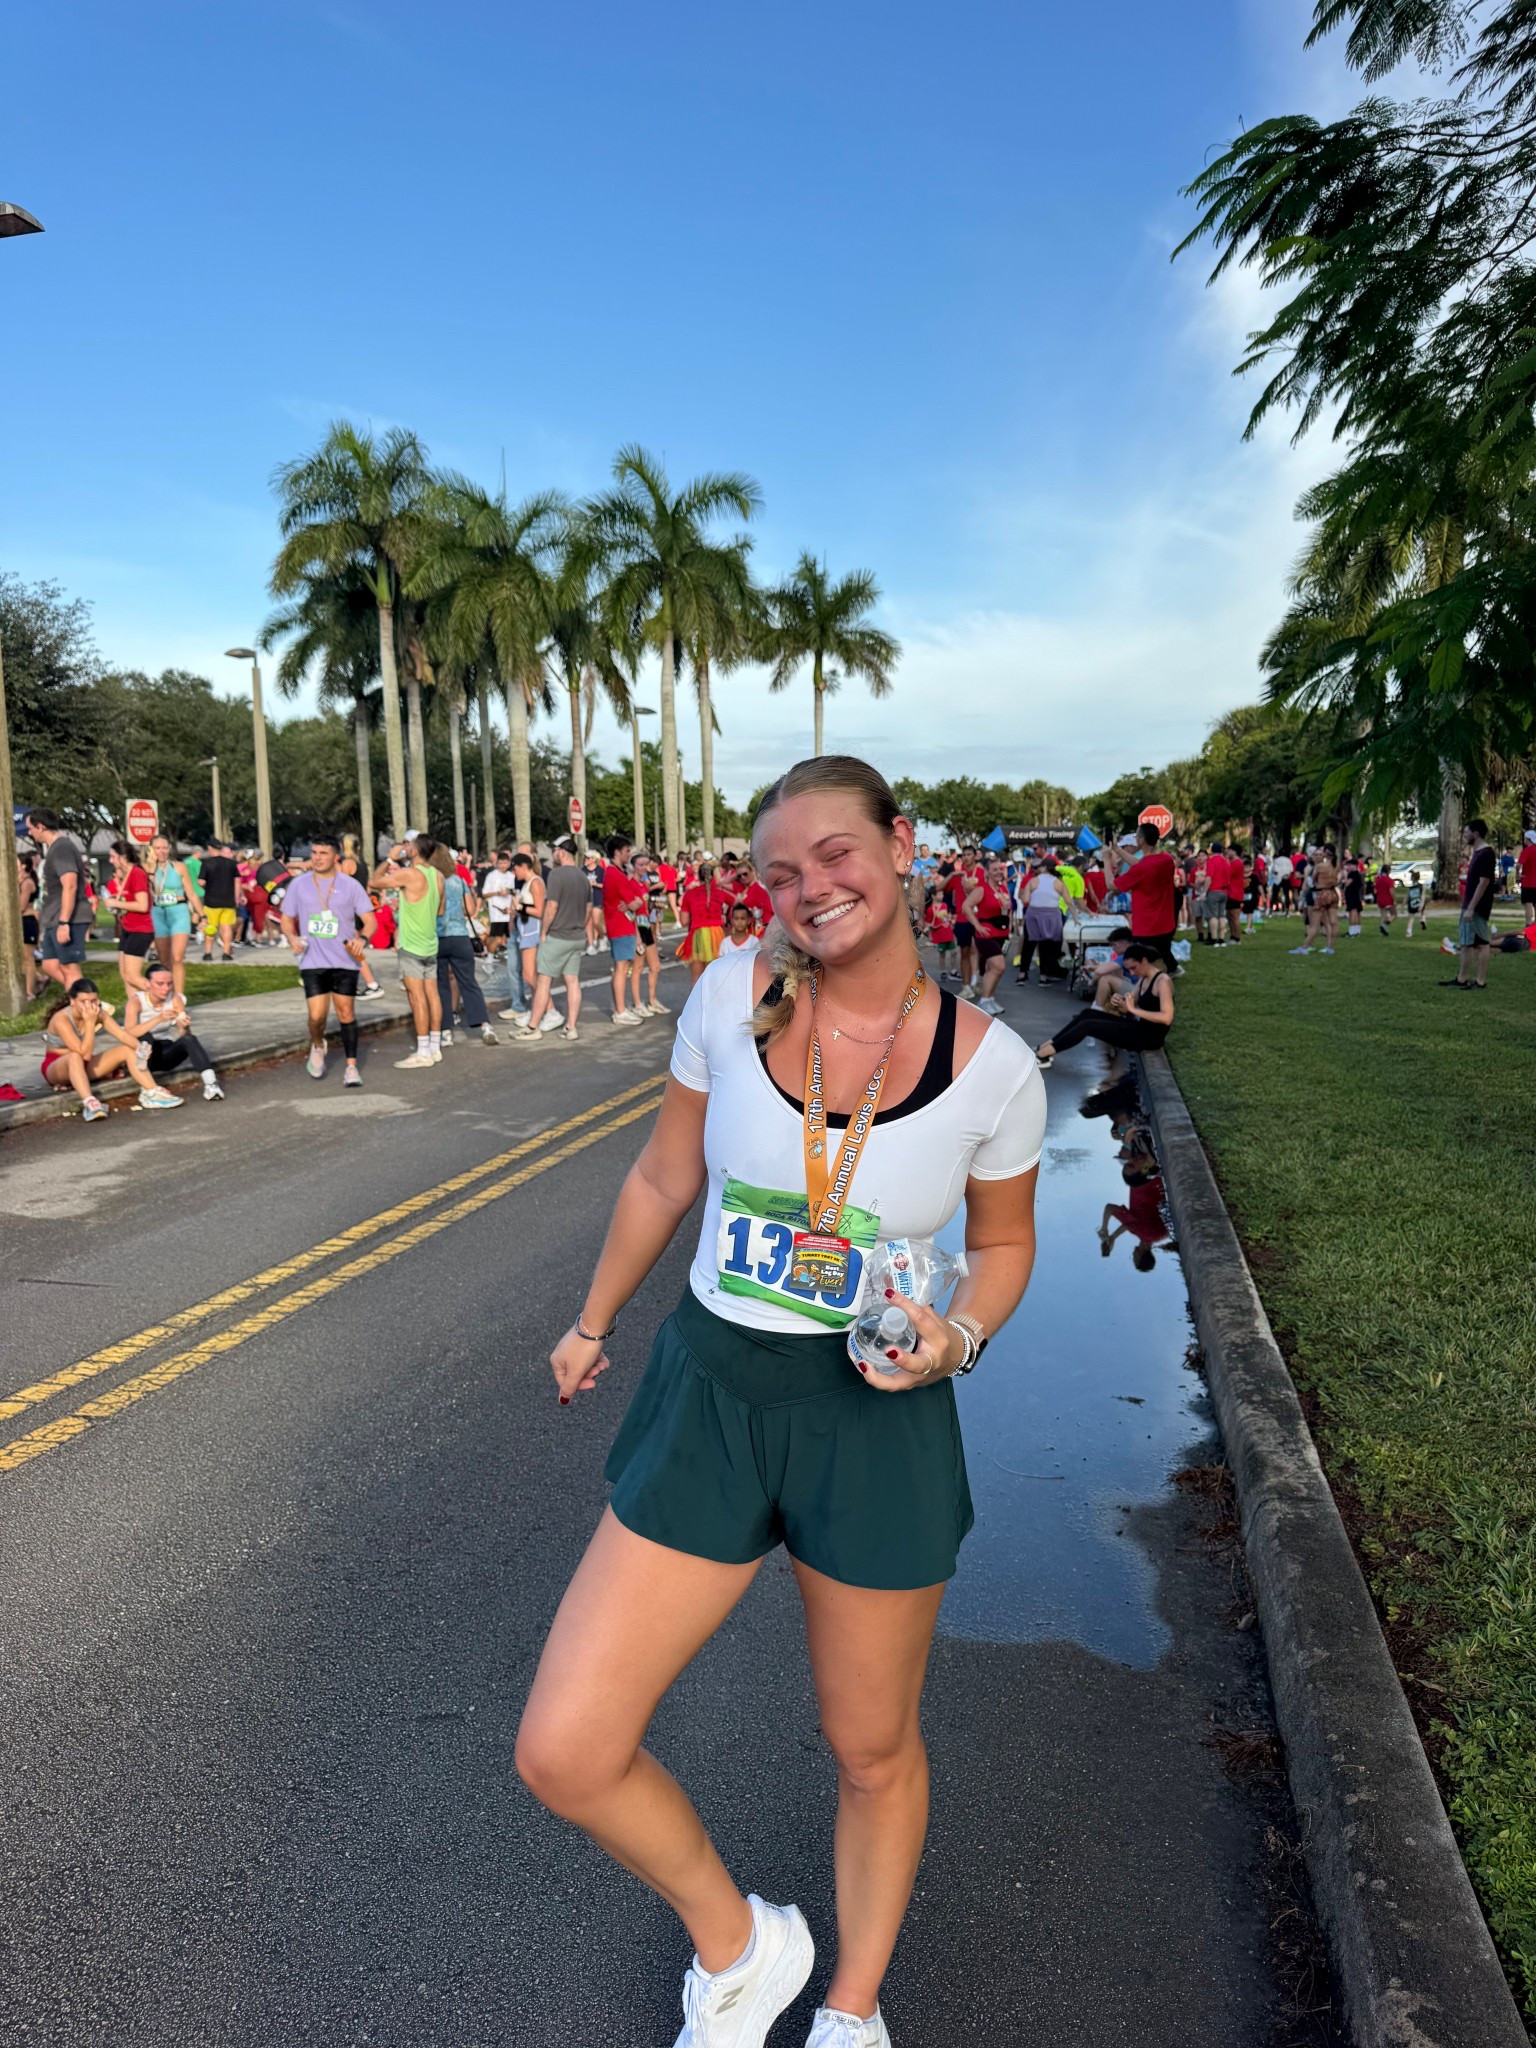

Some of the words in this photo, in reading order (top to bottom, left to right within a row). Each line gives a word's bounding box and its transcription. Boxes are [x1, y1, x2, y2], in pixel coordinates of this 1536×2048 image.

[131, 807, 141, 817] DO
[141, 808, 153, 817] NOT
[1141, 815, 1170, 829] STOP
[135, 826, 152, 836] ENTER
[1008, 830, 1048, 840] AccuChip
[1049, 830, 1075, 840] Timing
[313, 922, 333, 933] 379
[809, 1041, 823, 1095] Annual
[865, 1067, 884, 1101] JCC
[808, 1098, 823, 1133] 17th
[846, 1103, 874, 1144] Levis
[827, 1145, 858, 1206] Annual
[768, 1195, 807, 1208] RUNN
[764, 1211, 785, 1221] BOCA
[787, 1215, 811, 1227] RATON
[817, 1206, 839, 1233] 7th
[897, 1271, 910, 1296] WATER
